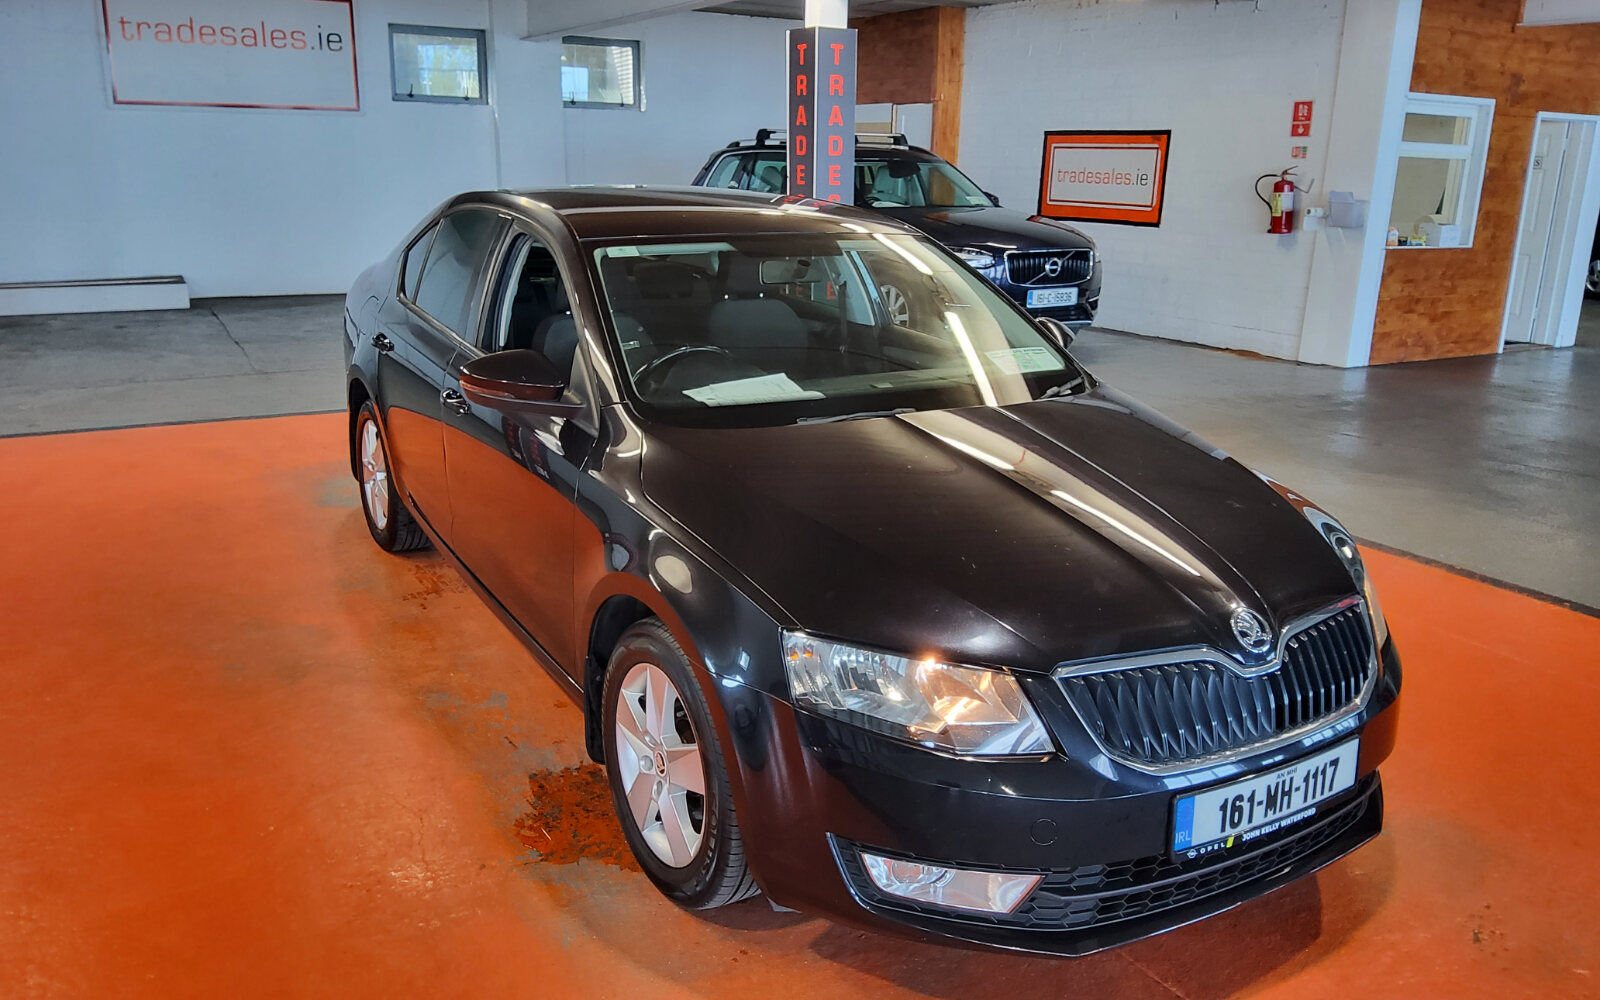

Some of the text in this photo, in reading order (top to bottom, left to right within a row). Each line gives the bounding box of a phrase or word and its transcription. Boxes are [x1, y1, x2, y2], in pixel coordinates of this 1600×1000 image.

[118, 16, 343, 52] tradesales.ie
[795, 43, 808, 198] TRADE
[1057, 166, 1149, 187] tradesales.ie
[1219, 757, 1340, 833] 161-MH-1117
[1175, 830, 1191, 844] IRL
[1242, 808, 1317, 841] JOHN KELLY WATERFORD
[1200, 842, 1225, 854] OPEL
